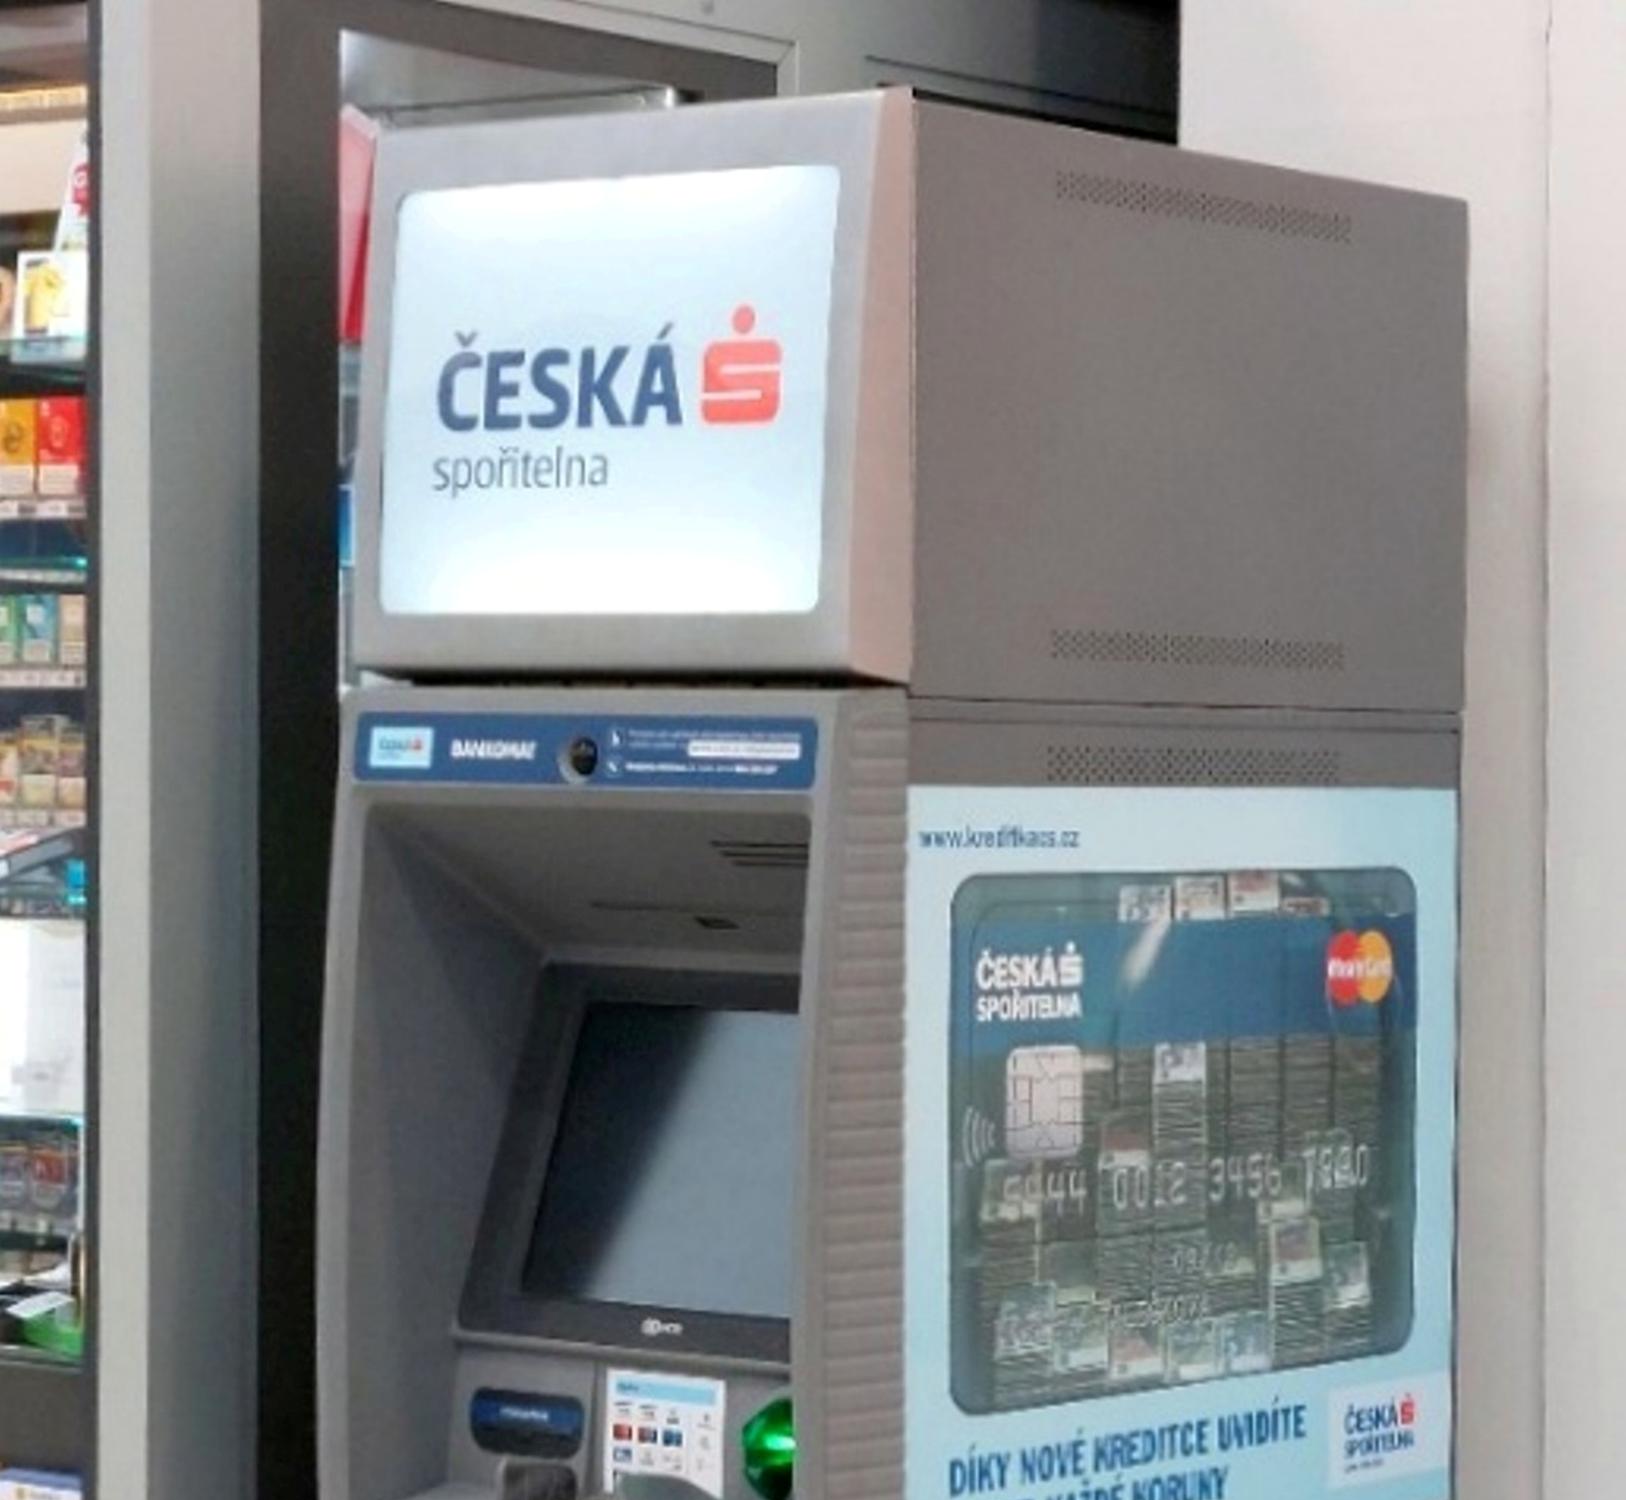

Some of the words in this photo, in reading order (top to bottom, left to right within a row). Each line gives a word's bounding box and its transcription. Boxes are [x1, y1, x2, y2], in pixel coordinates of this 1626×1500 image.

[436, 322, 684, 432] ČESKÁ
[432, 446, 610, 498] spořitelna
[451, 738, 537, 761] BANKOMAT
[976, 946, 1058, 990] ČESKÁ
[976, 988, 1083, 1022] SPOŘITELNA
[1208, 1153, 1282, 1201] 3456
[949, 1442, 1012, 1498] DÍKY
[1020, 1427, 1087, 1485] NOVÉ
[1093, 1419, 1210, 1472] KREDITCE
[1217, 1395, 1307, 1452] UVIDÍTE
